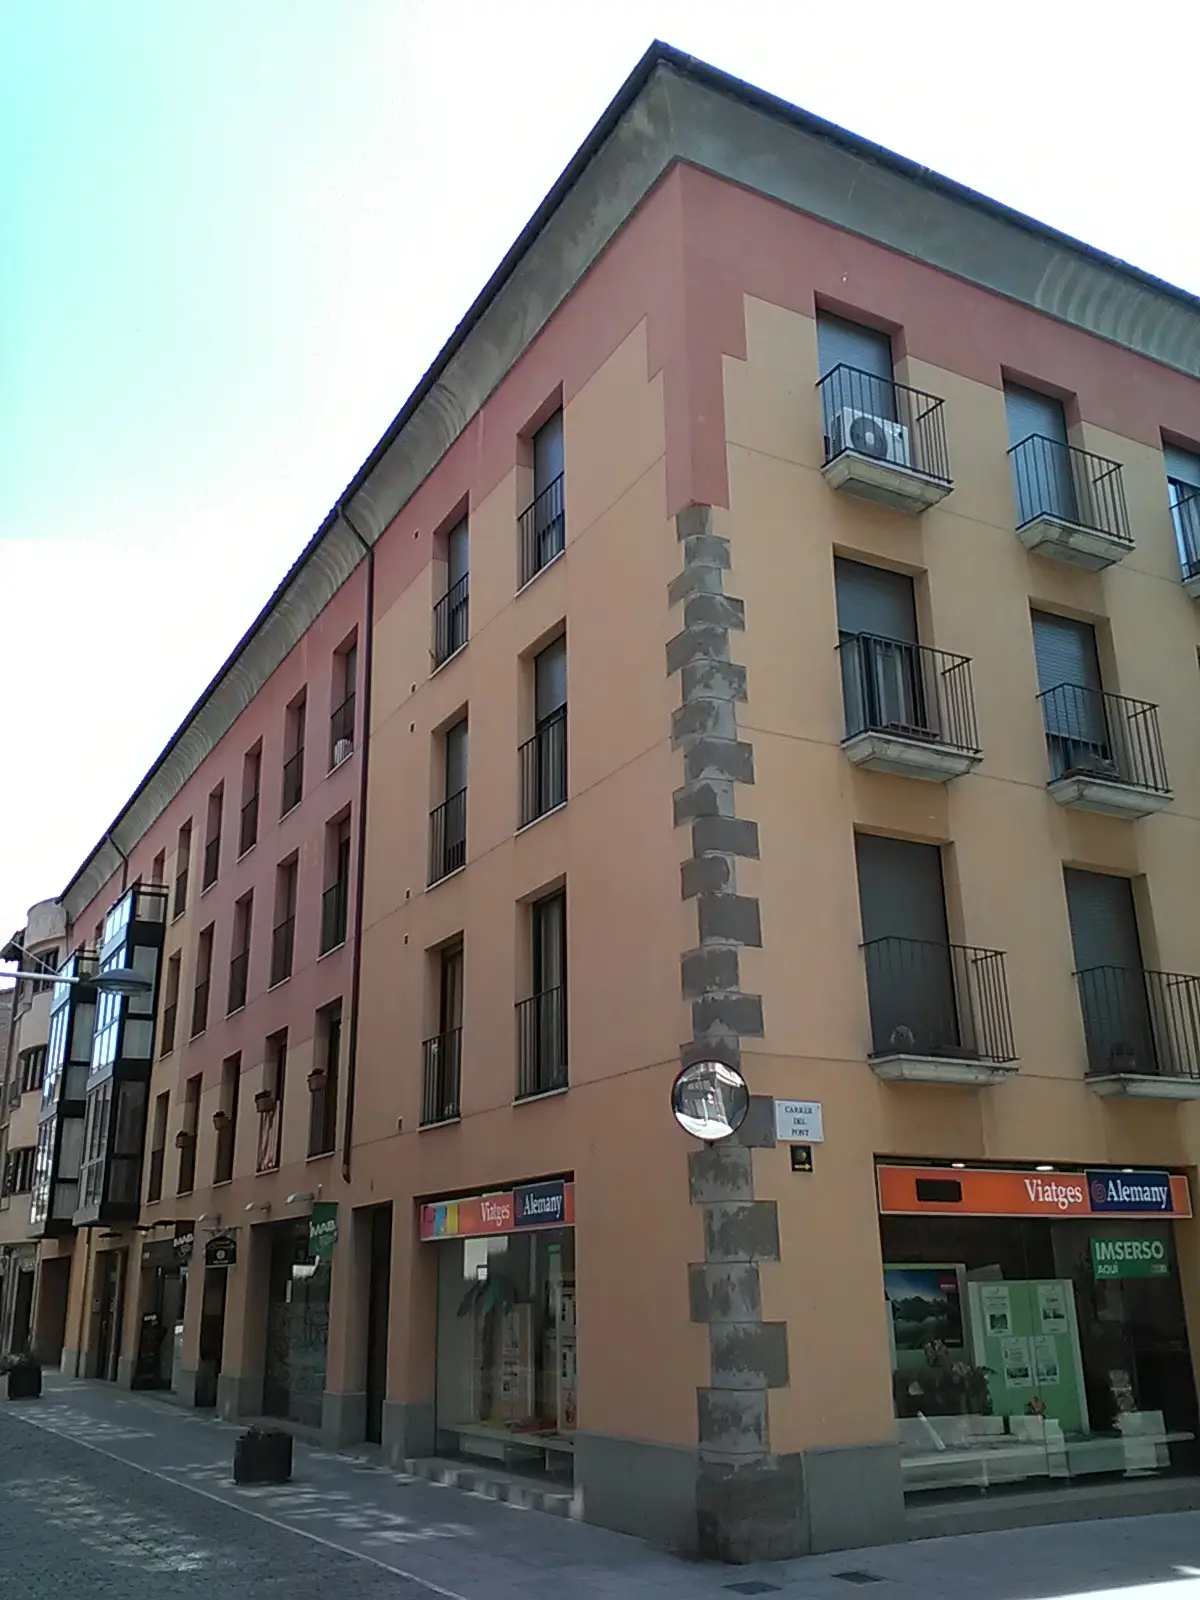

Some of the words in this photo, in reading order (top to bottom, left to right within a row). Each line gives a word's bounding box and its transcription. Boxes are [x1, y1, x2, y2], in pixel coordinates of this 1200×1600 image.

[784, 1105, 812, 1114] CARRER
[793, 1117, 807, 1125] DEL
[791, 1128, 809, 1136] PONT
[1024, 1178, 1083, 1210] Viatges
[1107, 1179, 1168, 1209] Alemany
[480, 1200, 511, 1226] Viatges
[523, 1193, 562, 1218] Alemany
[309, 1219, 336, 1238] MAB
[1095, 1241, 1164, 1260] IMSERSO
